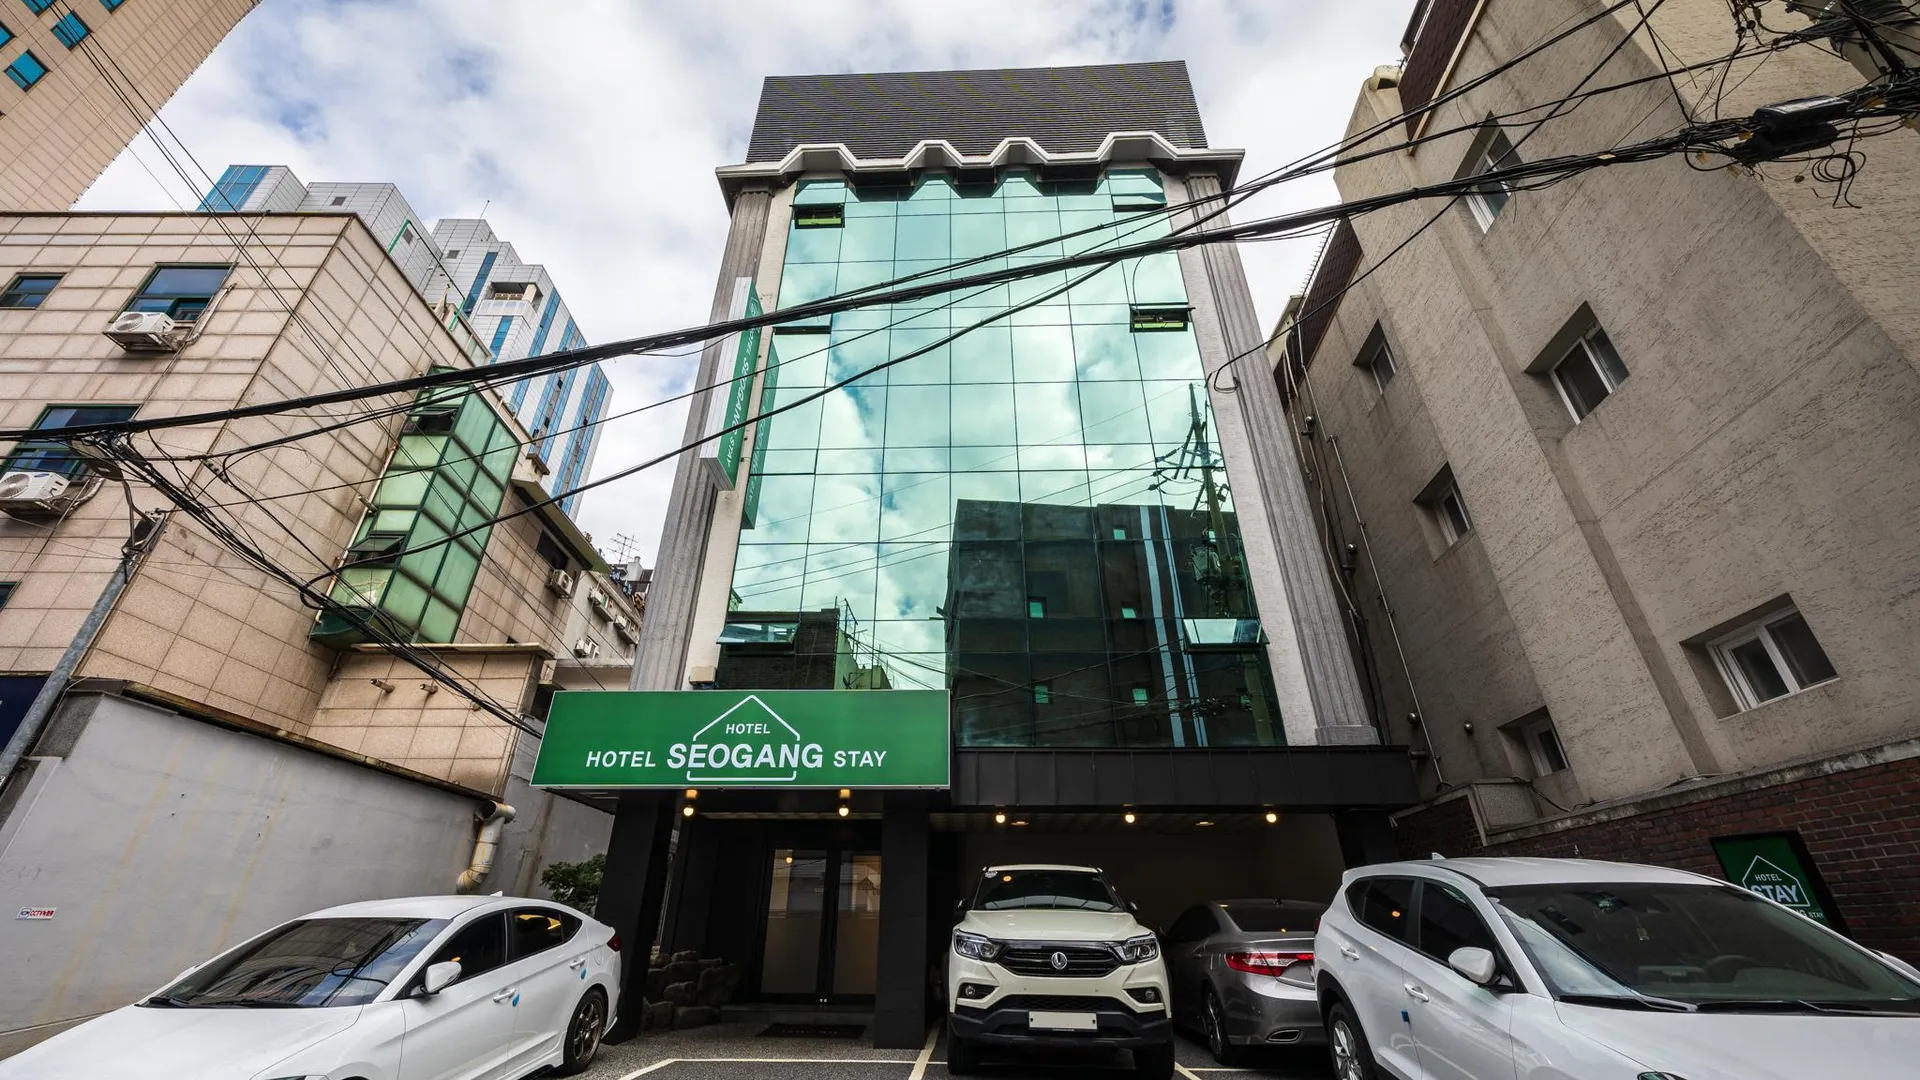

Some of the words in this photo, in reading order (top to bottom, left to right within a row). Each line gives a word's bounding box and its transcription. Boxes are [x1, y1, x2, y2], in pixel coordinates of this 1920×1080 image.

[746, 328, 754, 355] OTEL
[726, 437, 734, 467] STAY
[726, 723, 770, 734] HOTEL
[586, 751, 656, 768] HOTEL
[667, 743, 823, 768] SEOGANG
[833, 751, 886, 768] STAY
[1755, 874, 1782, 882] HOTEL
[1751, 885, 1798, 902] STAY
